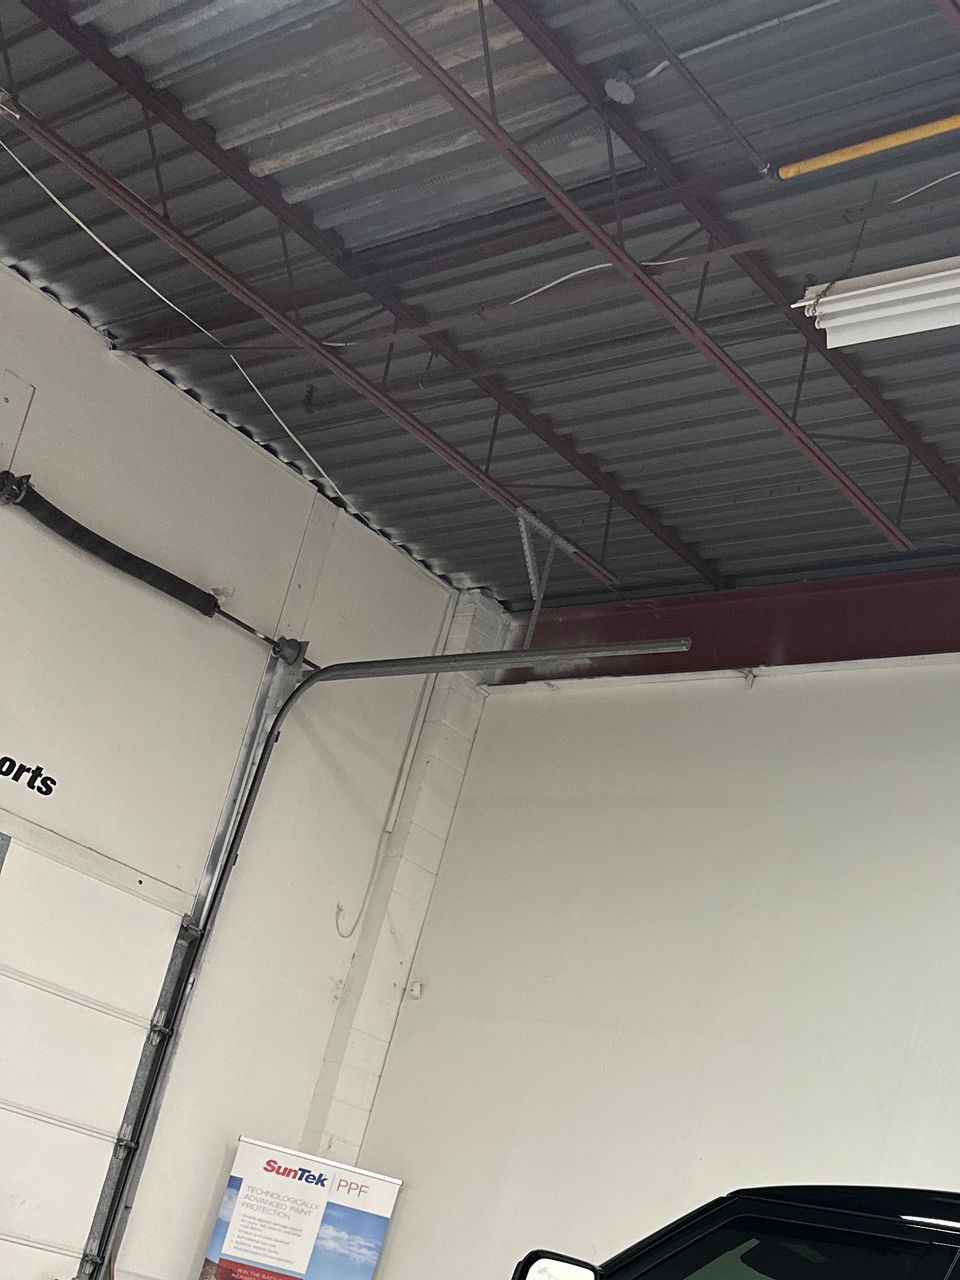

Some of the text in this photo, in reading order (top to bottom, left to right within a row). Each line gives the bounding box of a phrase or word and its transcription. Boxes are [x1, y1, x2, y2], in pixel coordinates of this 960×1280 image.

[0, 756, 57, 796] orts
[263, 1159, 370, 1197] SunTek PPF
[243, 1194, 312, 1217] ADVANCED PAINT
[247, 1185, 320, 1209] TECHNOLOGICALLY
[241, 1201, 291, 1220] PROTECTION
